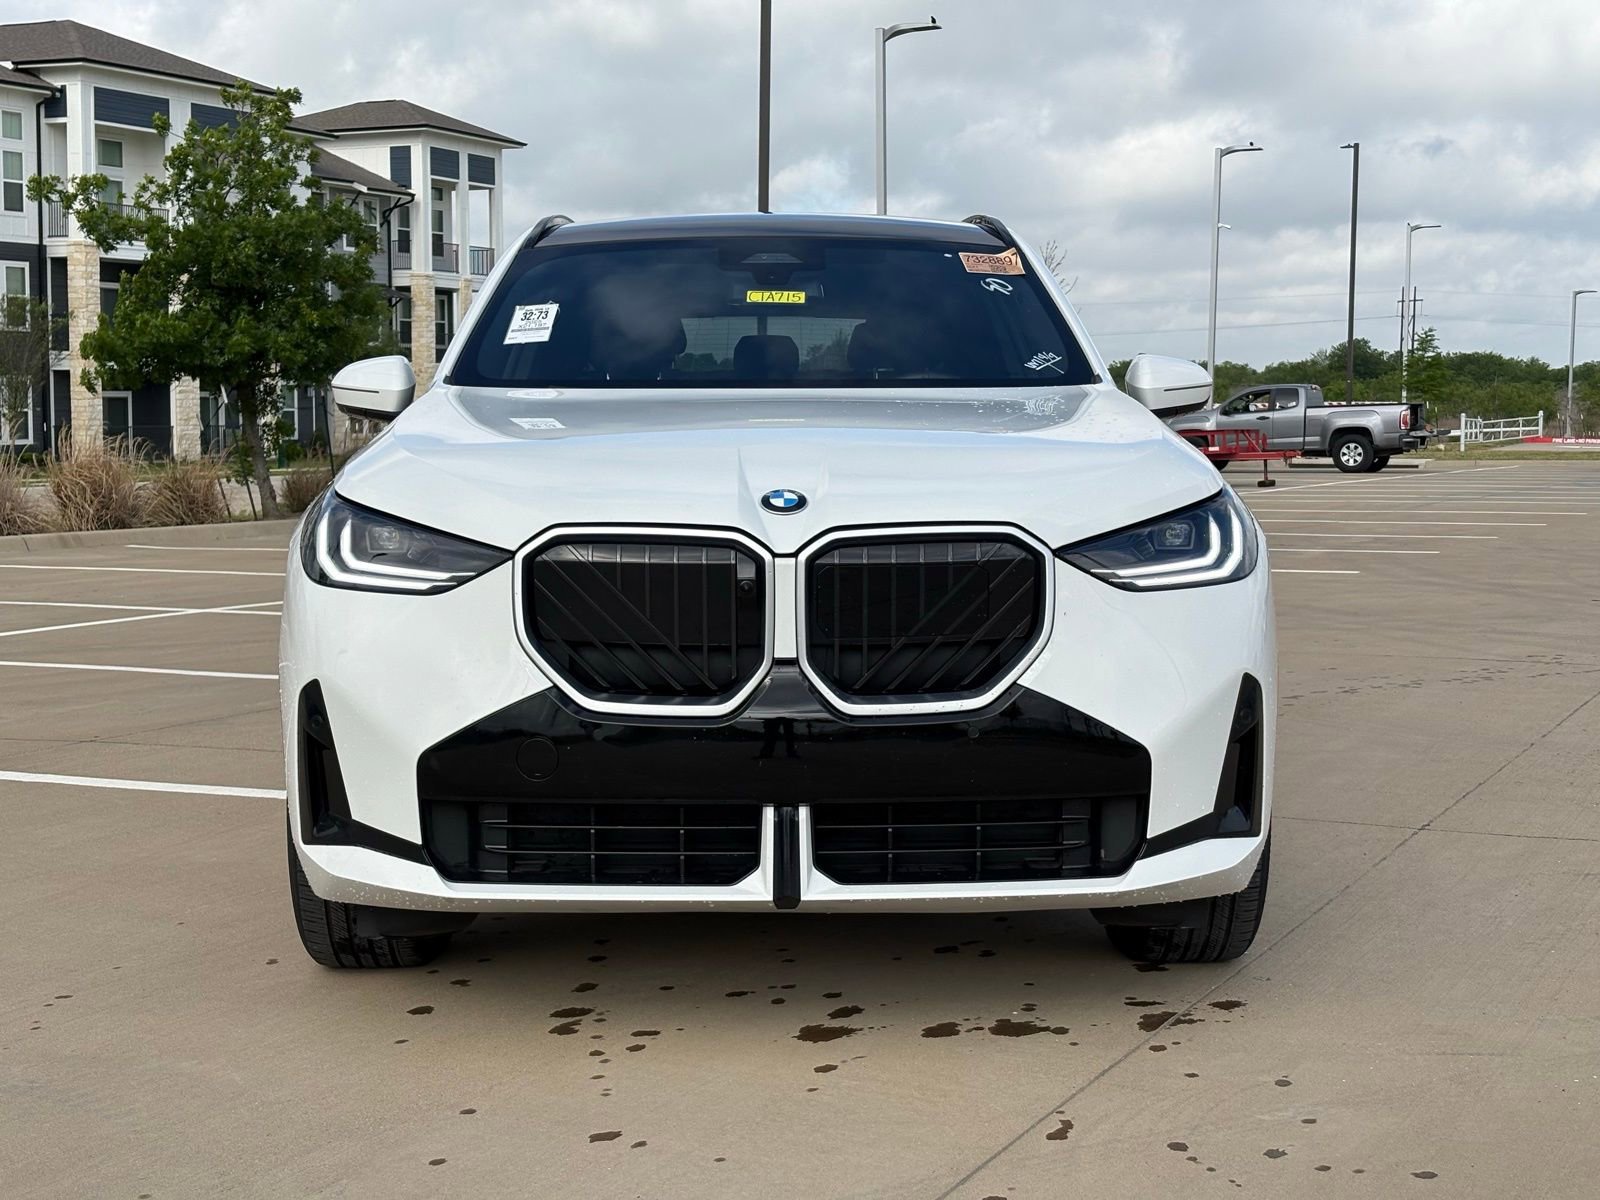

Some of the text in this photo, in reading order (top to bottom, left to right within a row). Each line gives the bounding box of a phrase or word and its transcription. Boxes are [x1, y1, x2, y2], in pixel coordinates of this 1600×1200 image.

[963, 252, 1018, 266] 7328897
[749, 291, 802, 302] CTA715
[520, 310, 549, 321] 32:73
